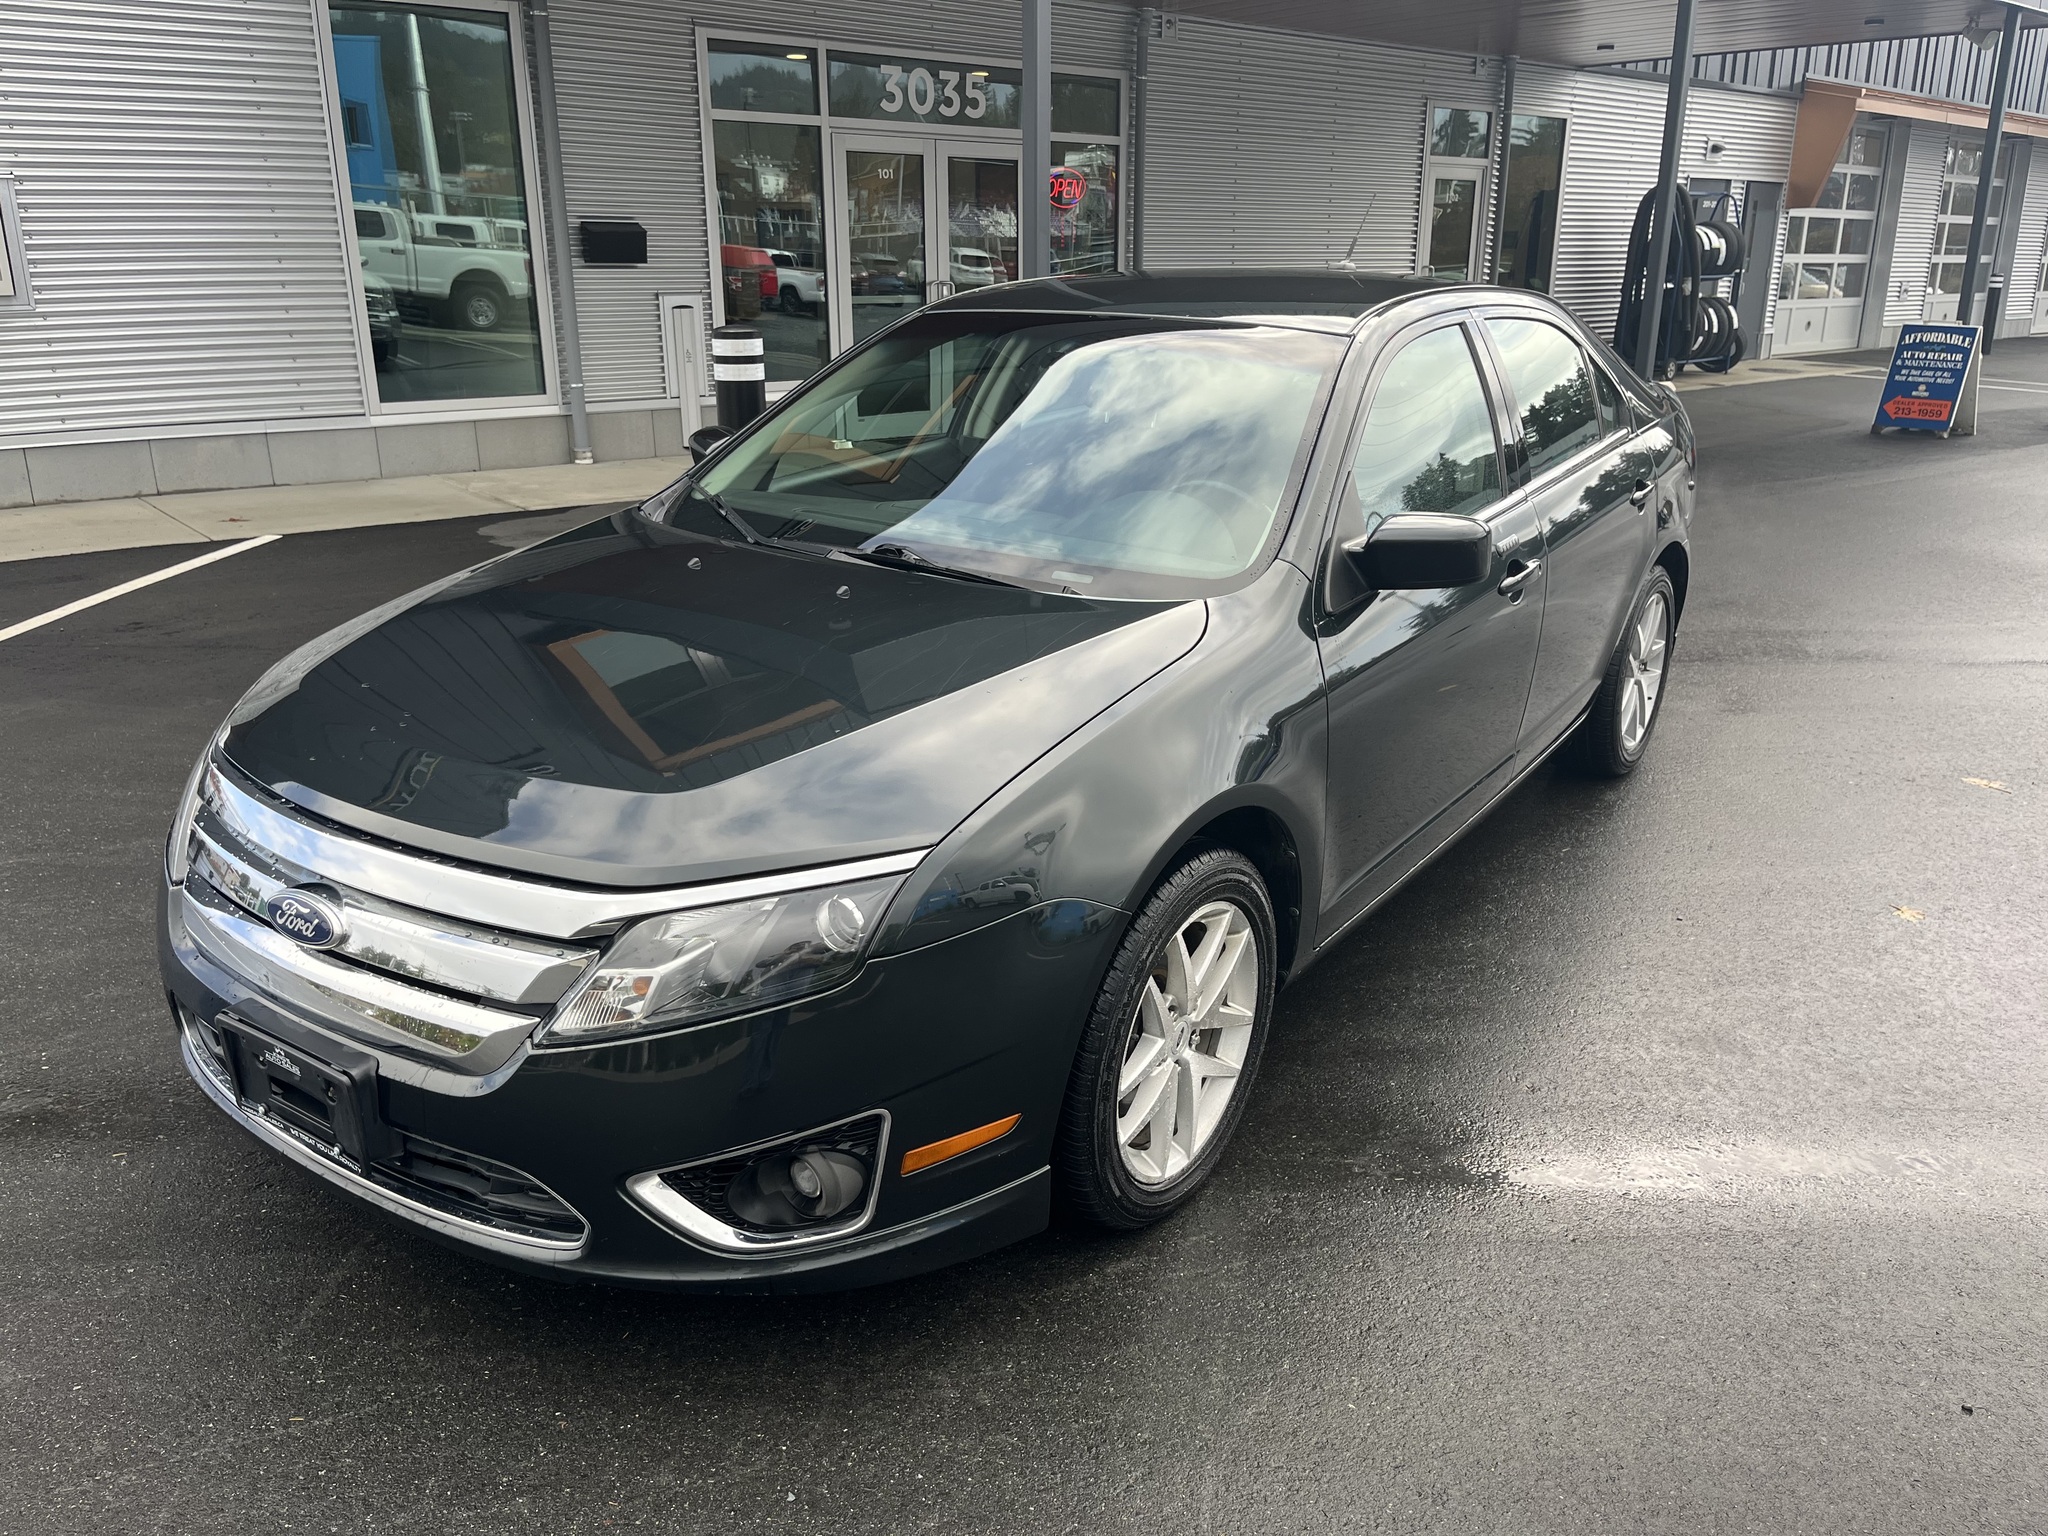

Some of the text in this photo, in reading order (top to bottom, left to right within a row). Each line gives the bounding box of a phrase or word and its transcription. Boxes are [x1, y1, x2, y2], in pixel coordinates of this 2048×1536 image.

[880, 64, 986, 119] 3035
[877, 168, 894, 180] 101
[1050, 178, 1083, 198] OPEN
[1901, 332, 1972, 348] AFFORDABLE
[1901, 351, 1963, 361] AUTO REPAIR
[1904, 360, 1963, 370] MAINTENANCE
[1893, 407, 1942, 418] 213-1959
[276, 900, 319, 938] Ford
[265, 1052, 282, 1066] AUTO
